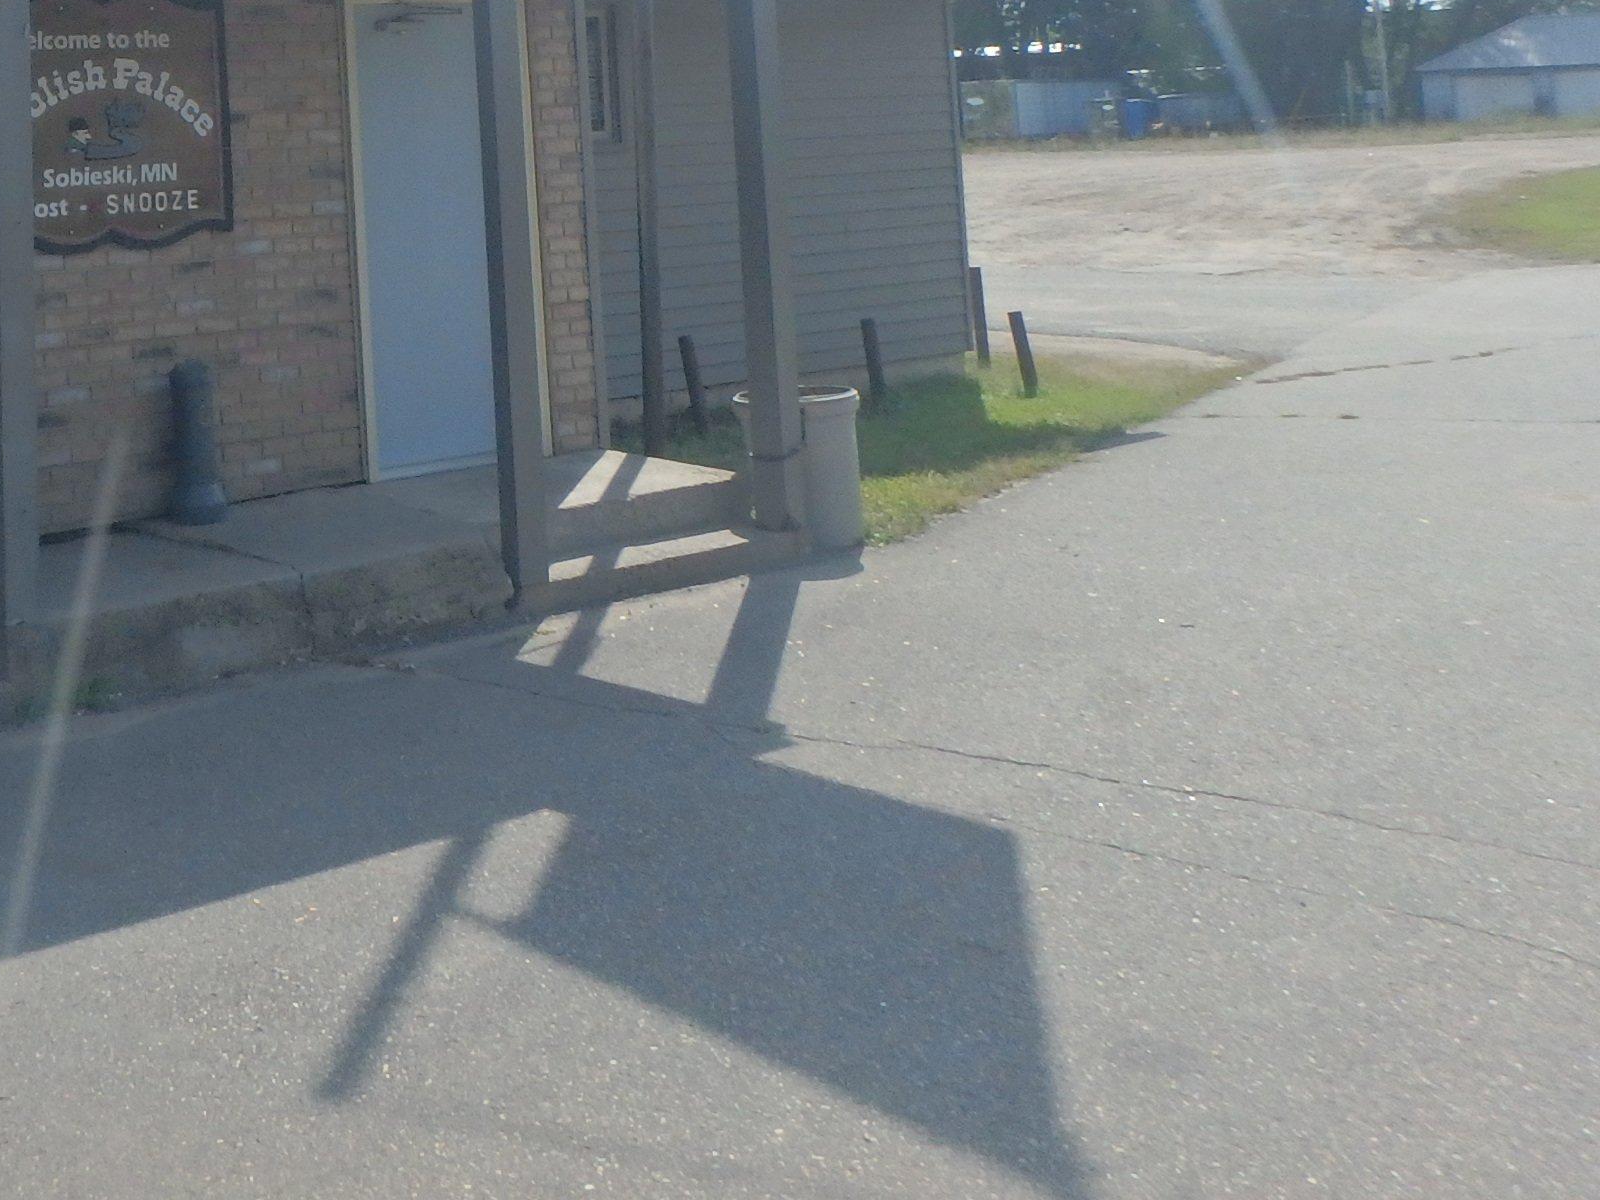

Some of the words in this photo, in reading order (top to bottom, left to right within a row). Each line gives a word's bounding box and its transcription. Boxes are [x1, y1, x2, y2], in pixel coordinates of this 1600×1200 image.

[29, 31, 100, 49] elcome
[106, 31, 129, 49] to
[134, 30, 170, 48] the
[31, 60, 107, 118] olish
[113, 57, 214, 137] Palace
[34, 199, 68, 218] ost
[106, 189, 199, 214] SNOOZE
